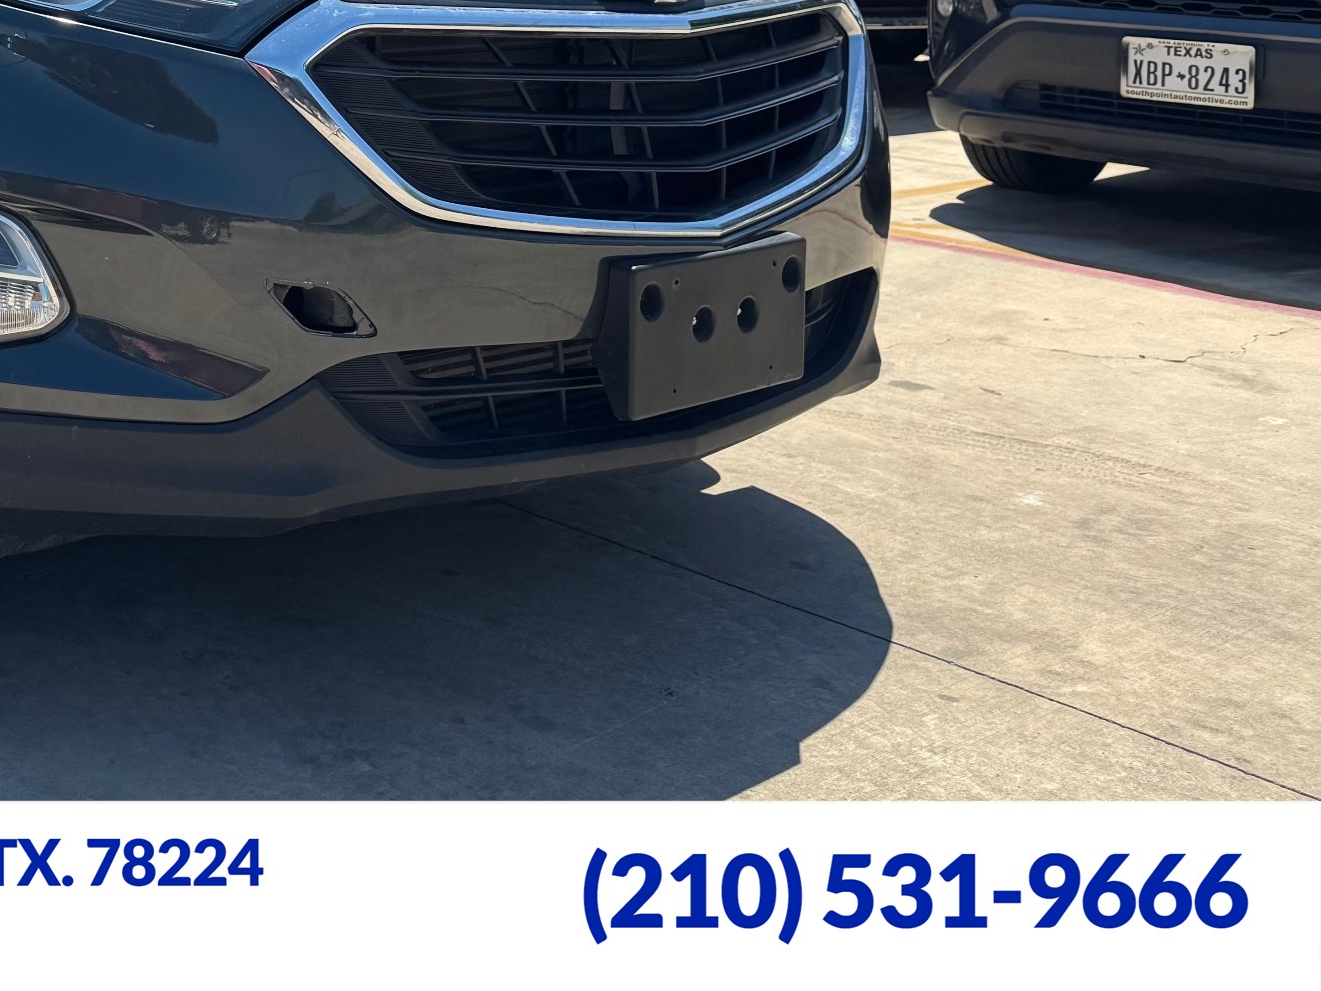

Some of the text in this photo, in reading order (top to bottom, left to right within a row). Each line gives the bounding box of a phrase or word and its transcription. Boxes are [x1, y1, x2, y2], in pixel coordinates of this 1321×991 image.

[1164, 45, 1214, 59] TEXAS
[1132, 59, 1247, 95] XBP 8243
[1125, 89, 1249, 107] southpointautomotive.com
